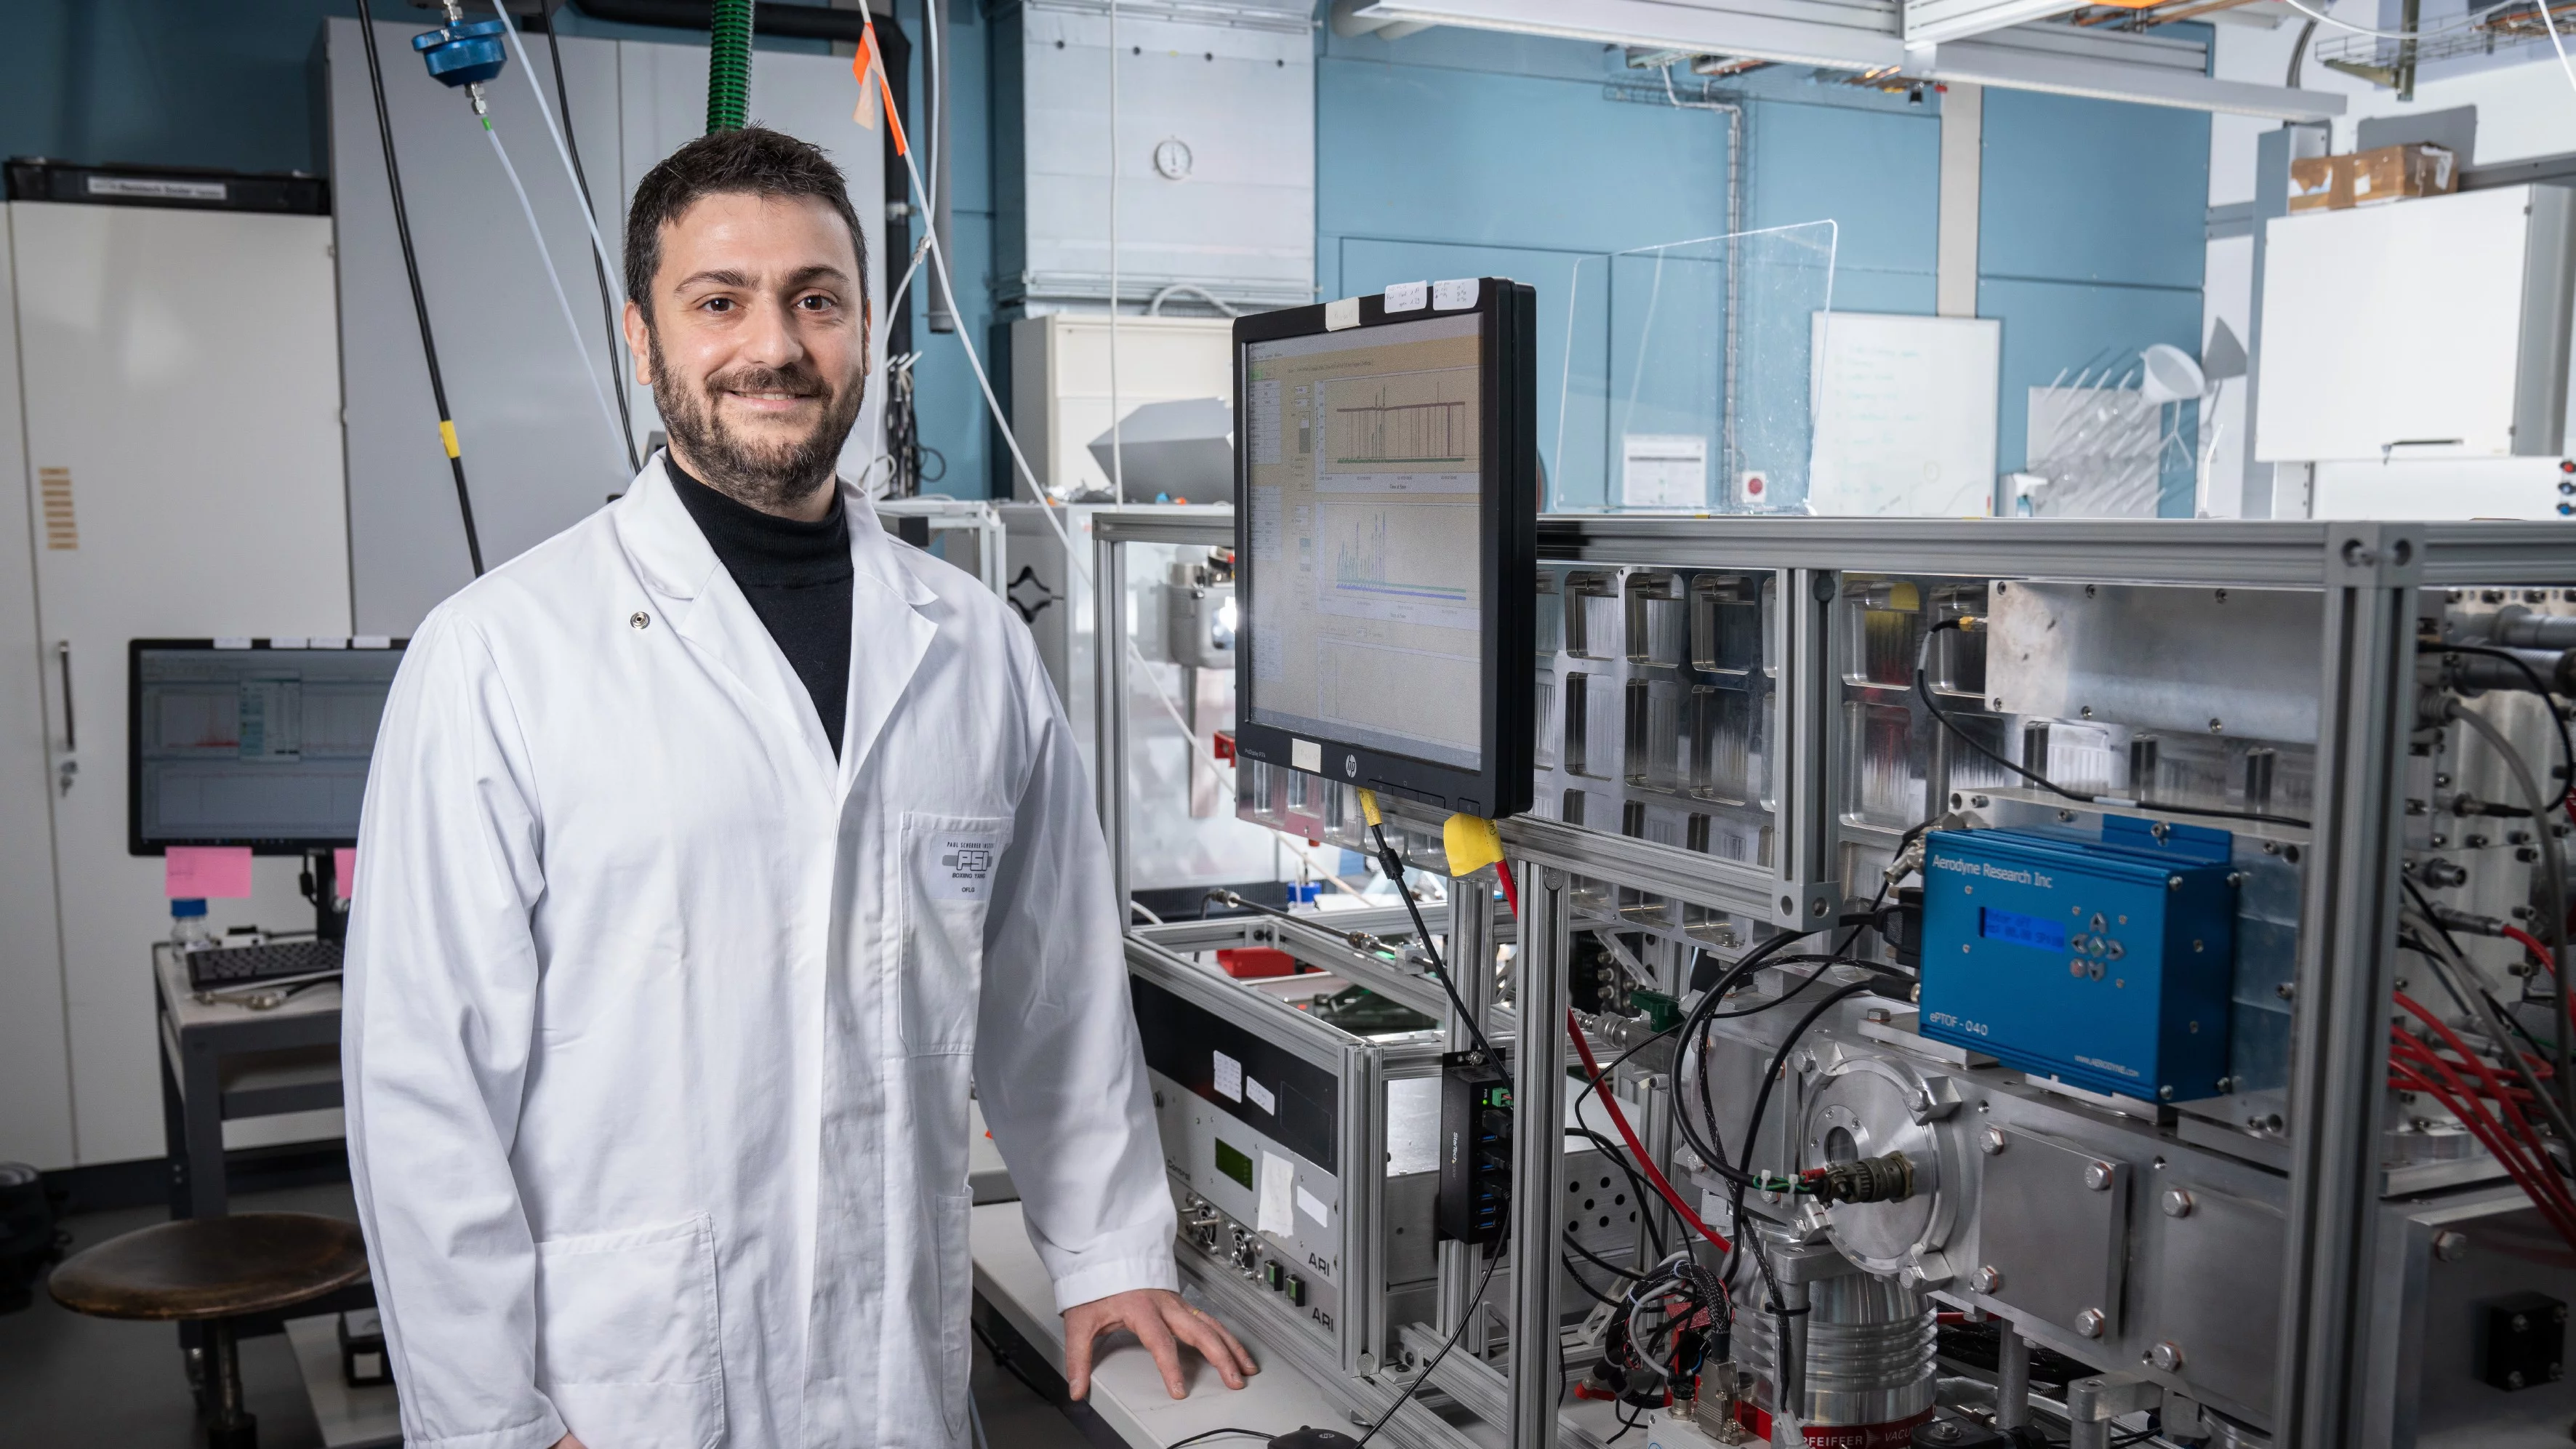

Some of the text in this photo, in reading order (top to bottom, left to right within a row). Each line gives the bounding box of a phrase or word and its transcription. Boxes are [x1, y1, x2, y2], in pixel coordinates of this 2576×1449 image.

[1347, 754, 1356, 778] hp
[956, 850, 989, 871] PSI
[1932, 854, 2053, 888] Aerodyne Research Inc
[1929, 1011, 1958, 1027] ePTOF
[1965, 1019, 1989, 1037] 040
[1166, 1158, 1191, 1181] Control
[1308, 1252, 1330, 1277] ARI
[1312, 1306, 1333, 1333] ARI
